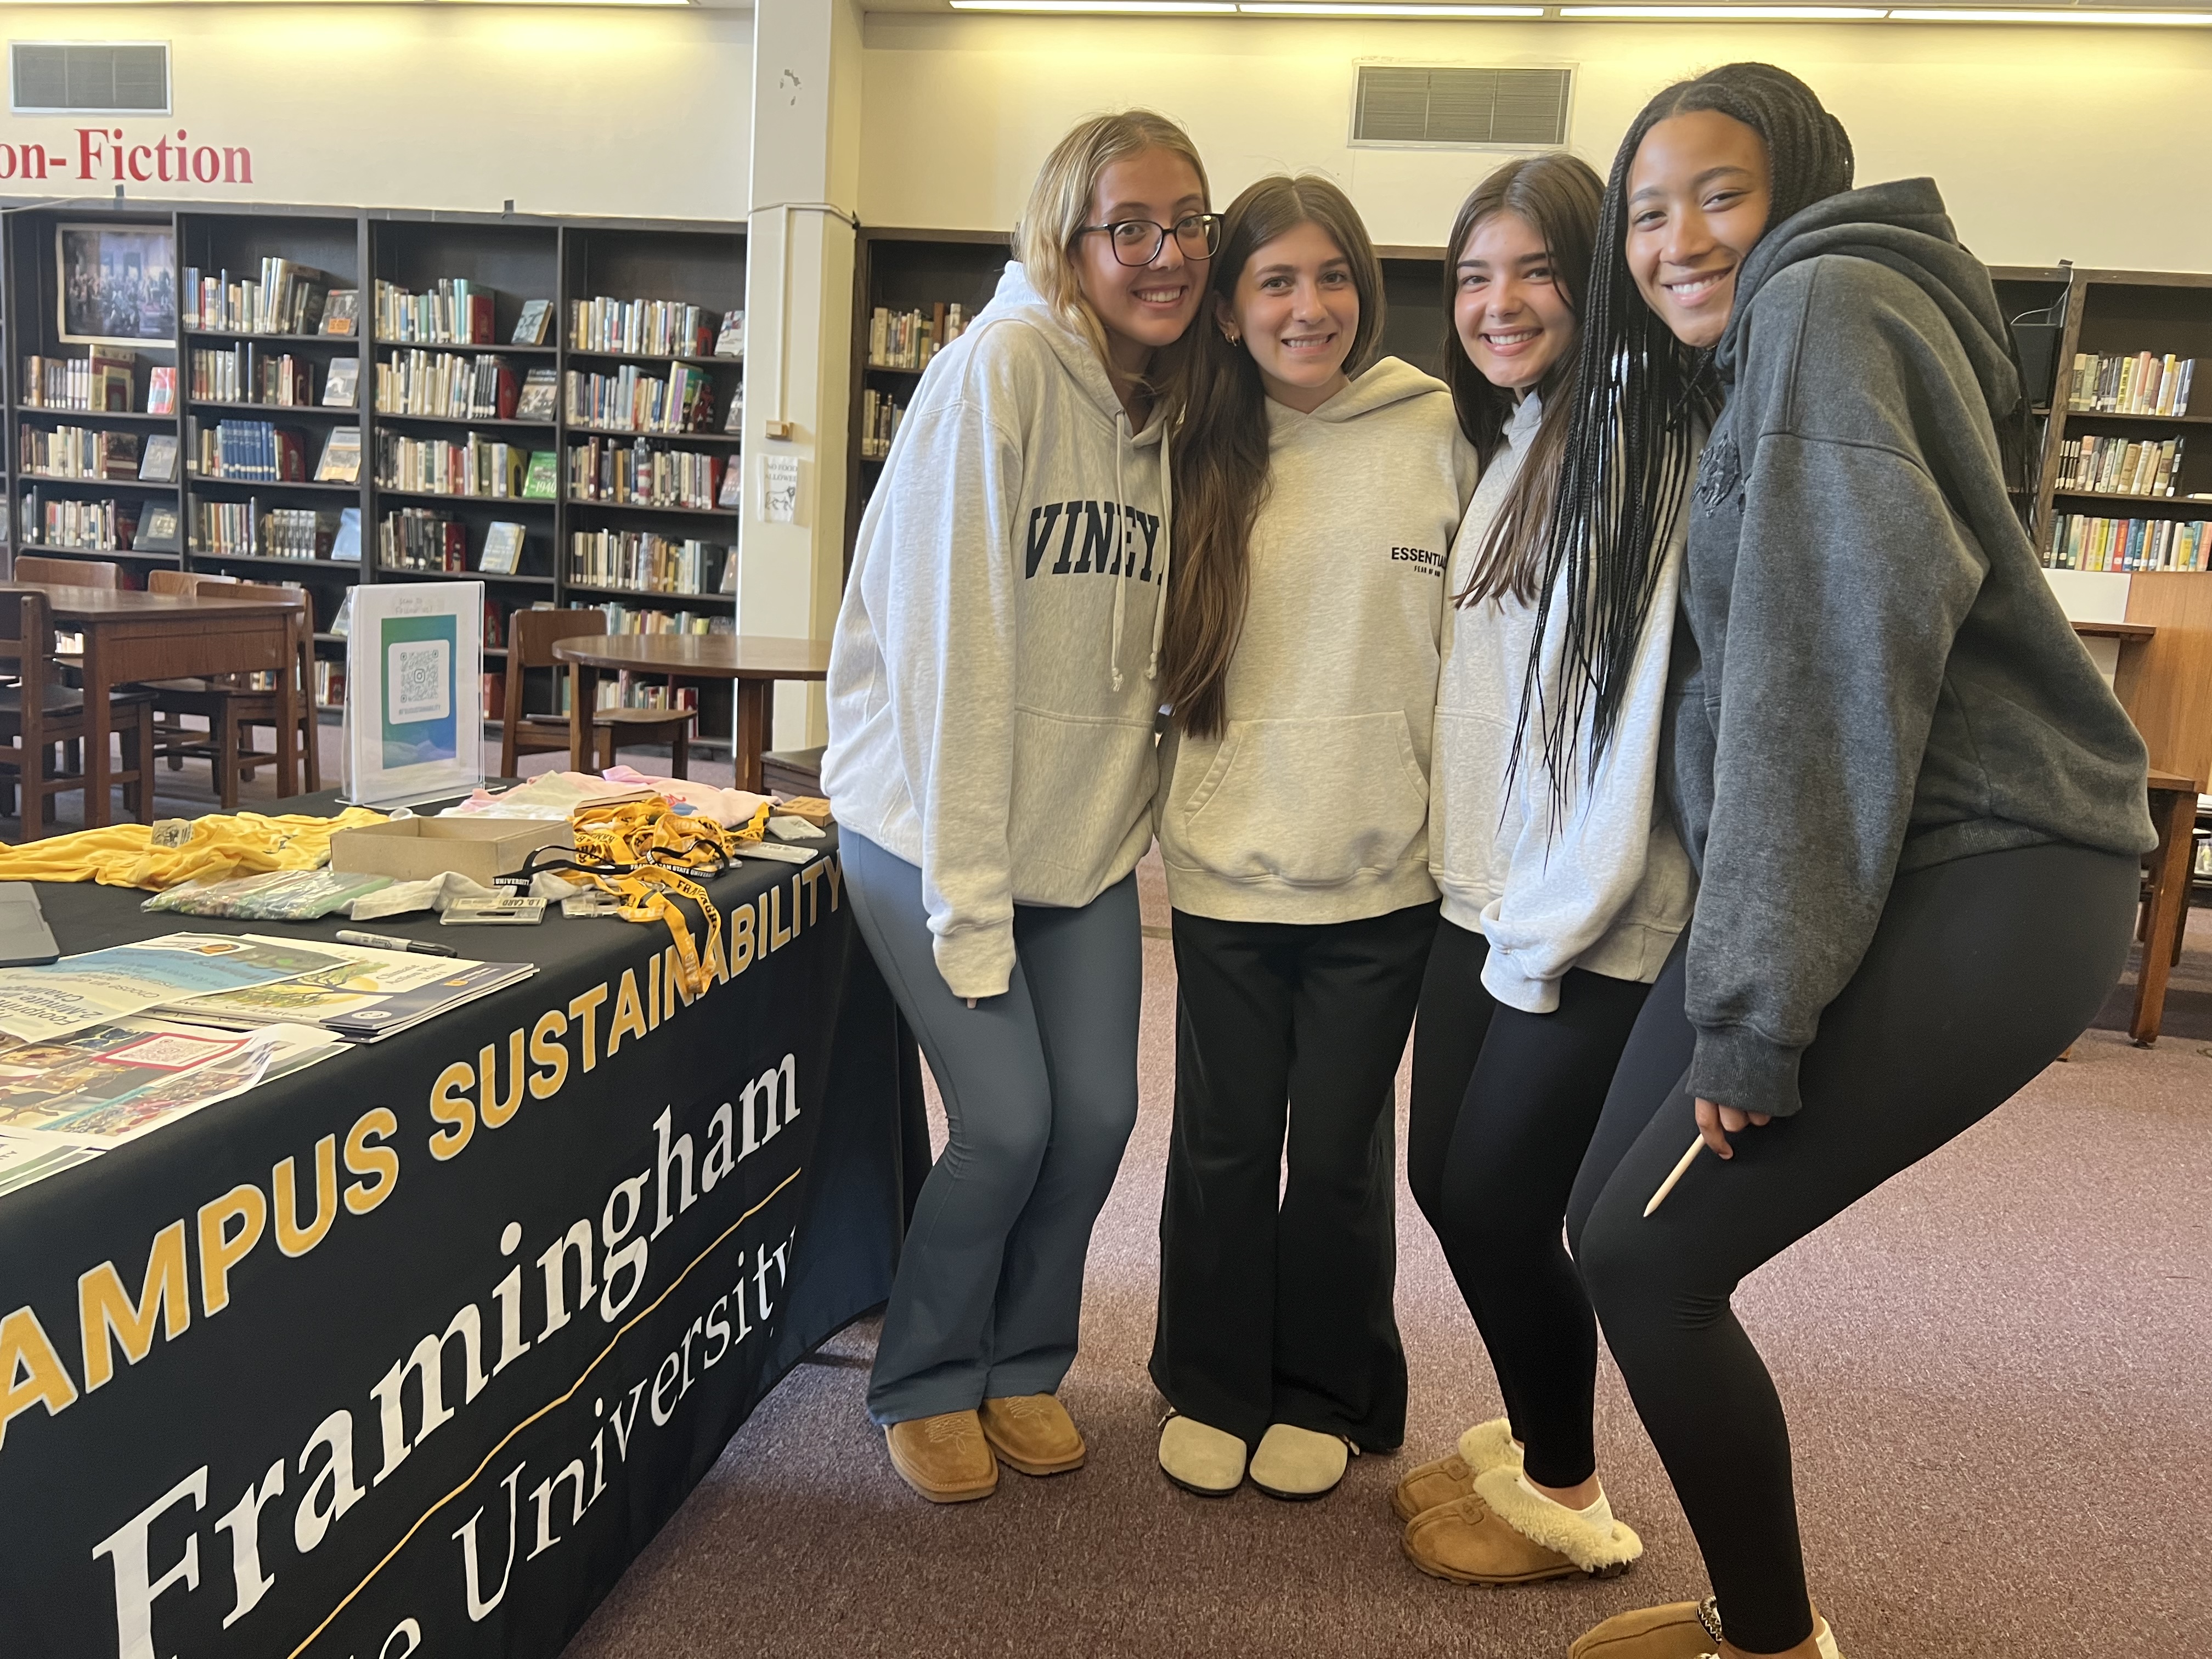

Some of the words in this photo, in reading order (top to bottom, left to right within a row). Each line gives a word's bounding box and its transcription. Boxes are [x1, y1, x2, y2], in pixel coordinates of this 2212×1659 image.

[1414, 565, 1427, 573] FEAR
[502, 899, 524, 907] CARD
[376, 964, 420, 980] Climate
[108, 984, 160, 998] Choose
[429, 849, 844, 1161] SUSTAINABILITY
[92, 1053, 801, 1659] Framingham
